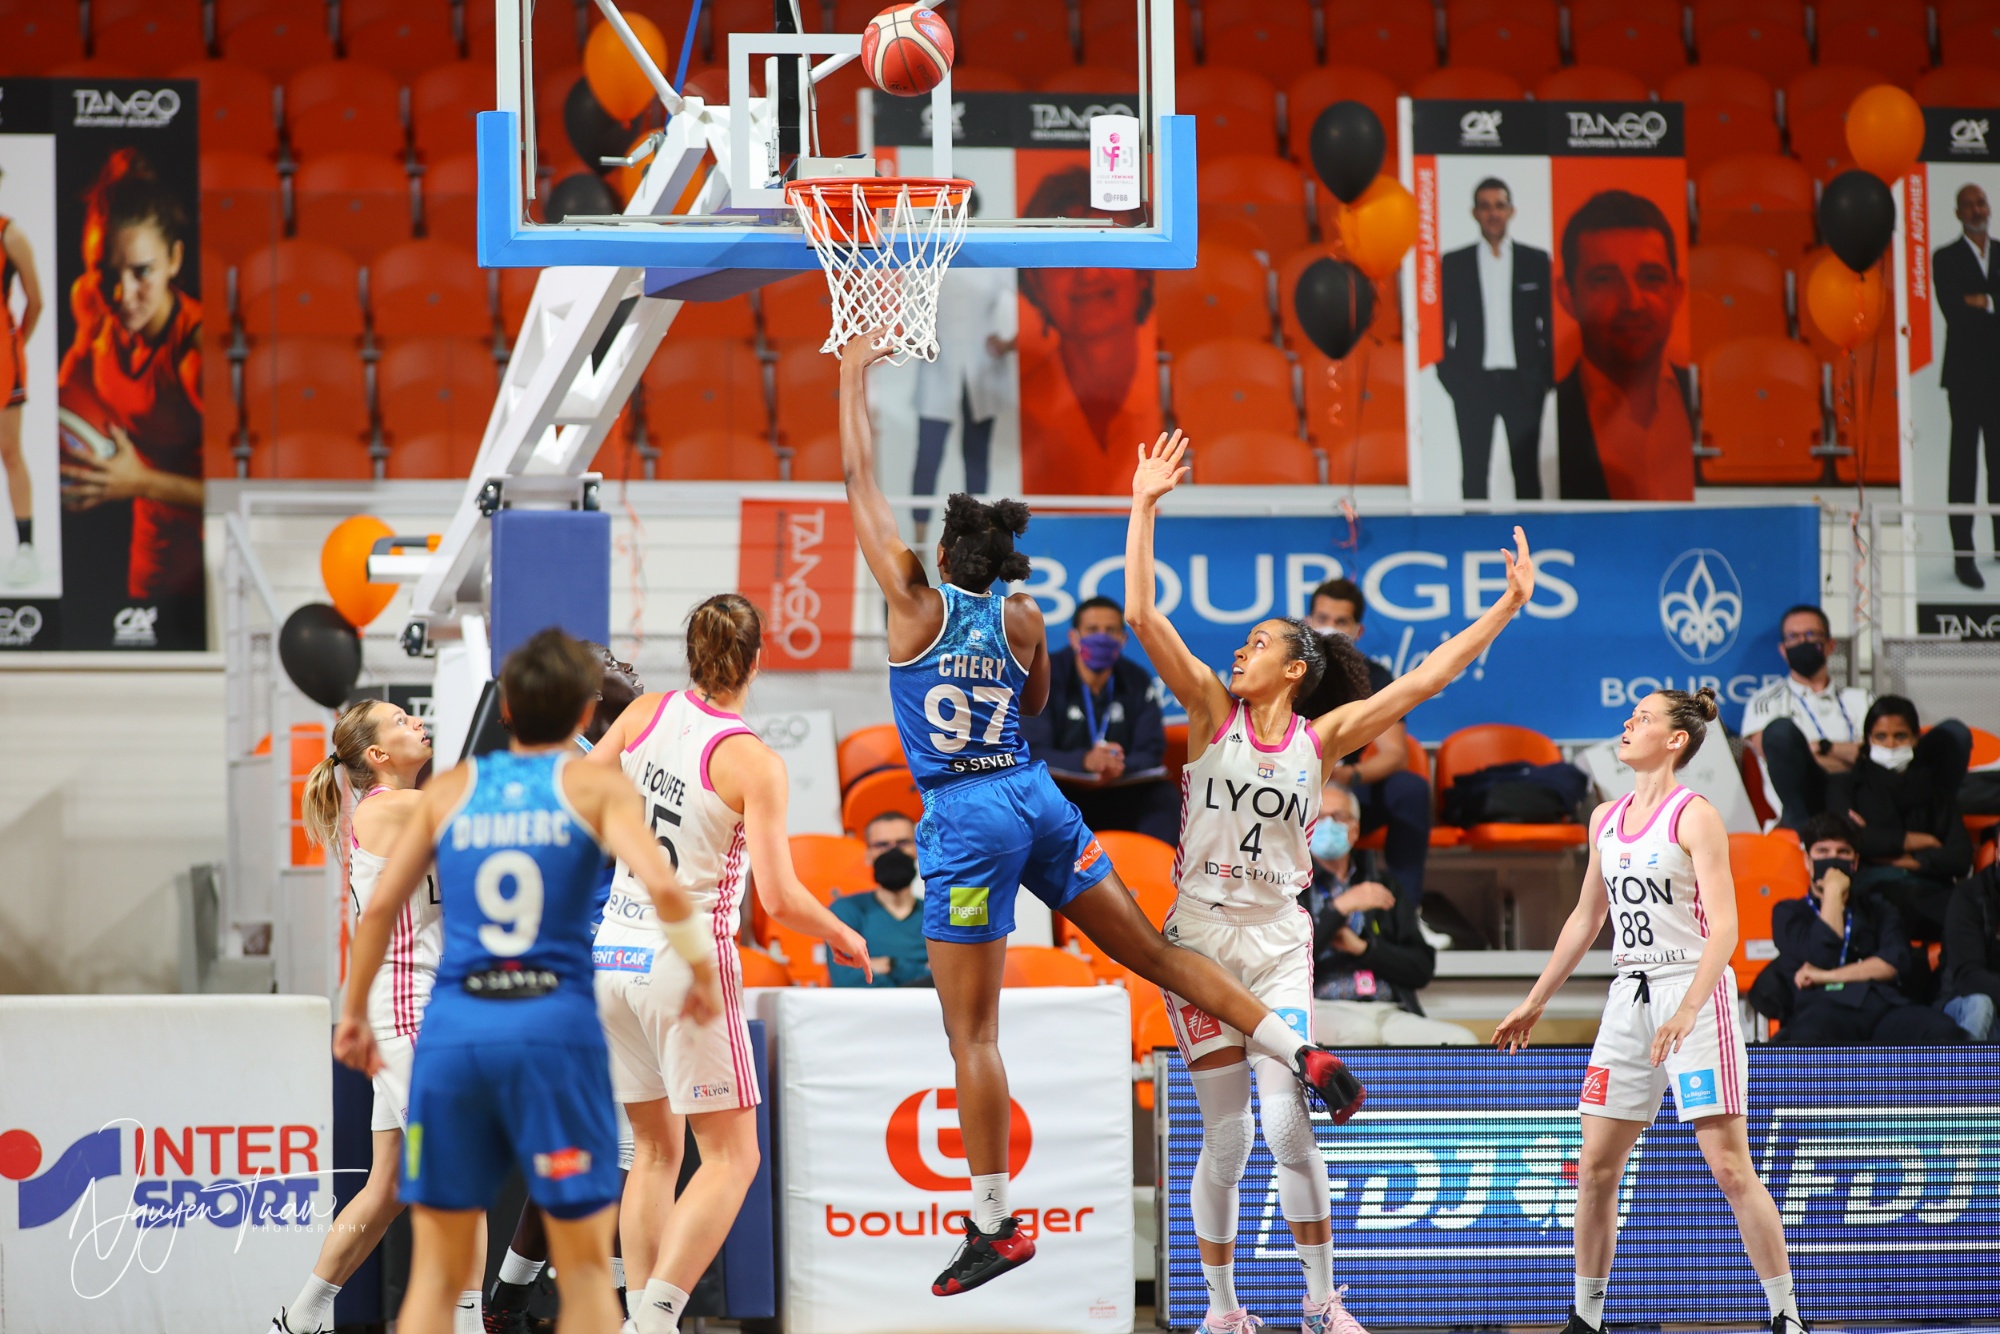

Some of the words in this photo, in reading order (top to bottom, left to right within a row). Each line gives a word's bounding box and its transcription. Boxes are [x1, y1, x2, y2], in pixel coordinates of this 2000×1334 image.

[73, 88, 181, 117] TANGO
[1566, 110, 1667, 141] TANGO
[785, 508, 825, 660] TANGO
[938, 653, 1006, 681] CHERY
[924, 684, 1014, 753] 97
[970, 754, 1016, 771] SEVER
[1206, 778, 1308, 827] LYON
[452, 810, 572, 851] DUMERC
[1240, 823, 1262, 861] 4
[1205, 861, 1243, 878] IDEC
[1245, 867, 1293, 885] SPORT
[1604, 876, 1674, 905] YON
[474, 850, 545, 958] 9
[949, 903, 982, 919] mgen
[1620, 911, 1654, 949] 88
[624, 951, 646, 966] CAR
[708, 1086, 729, 1097] LYON
[134, 1125, 320, 1177] INTER
[1782, 1137, 1980, 1224] FDJ
[133, 1178, 320, 1229] SPORT
[826, 1203, 1094, 1241] boulager
